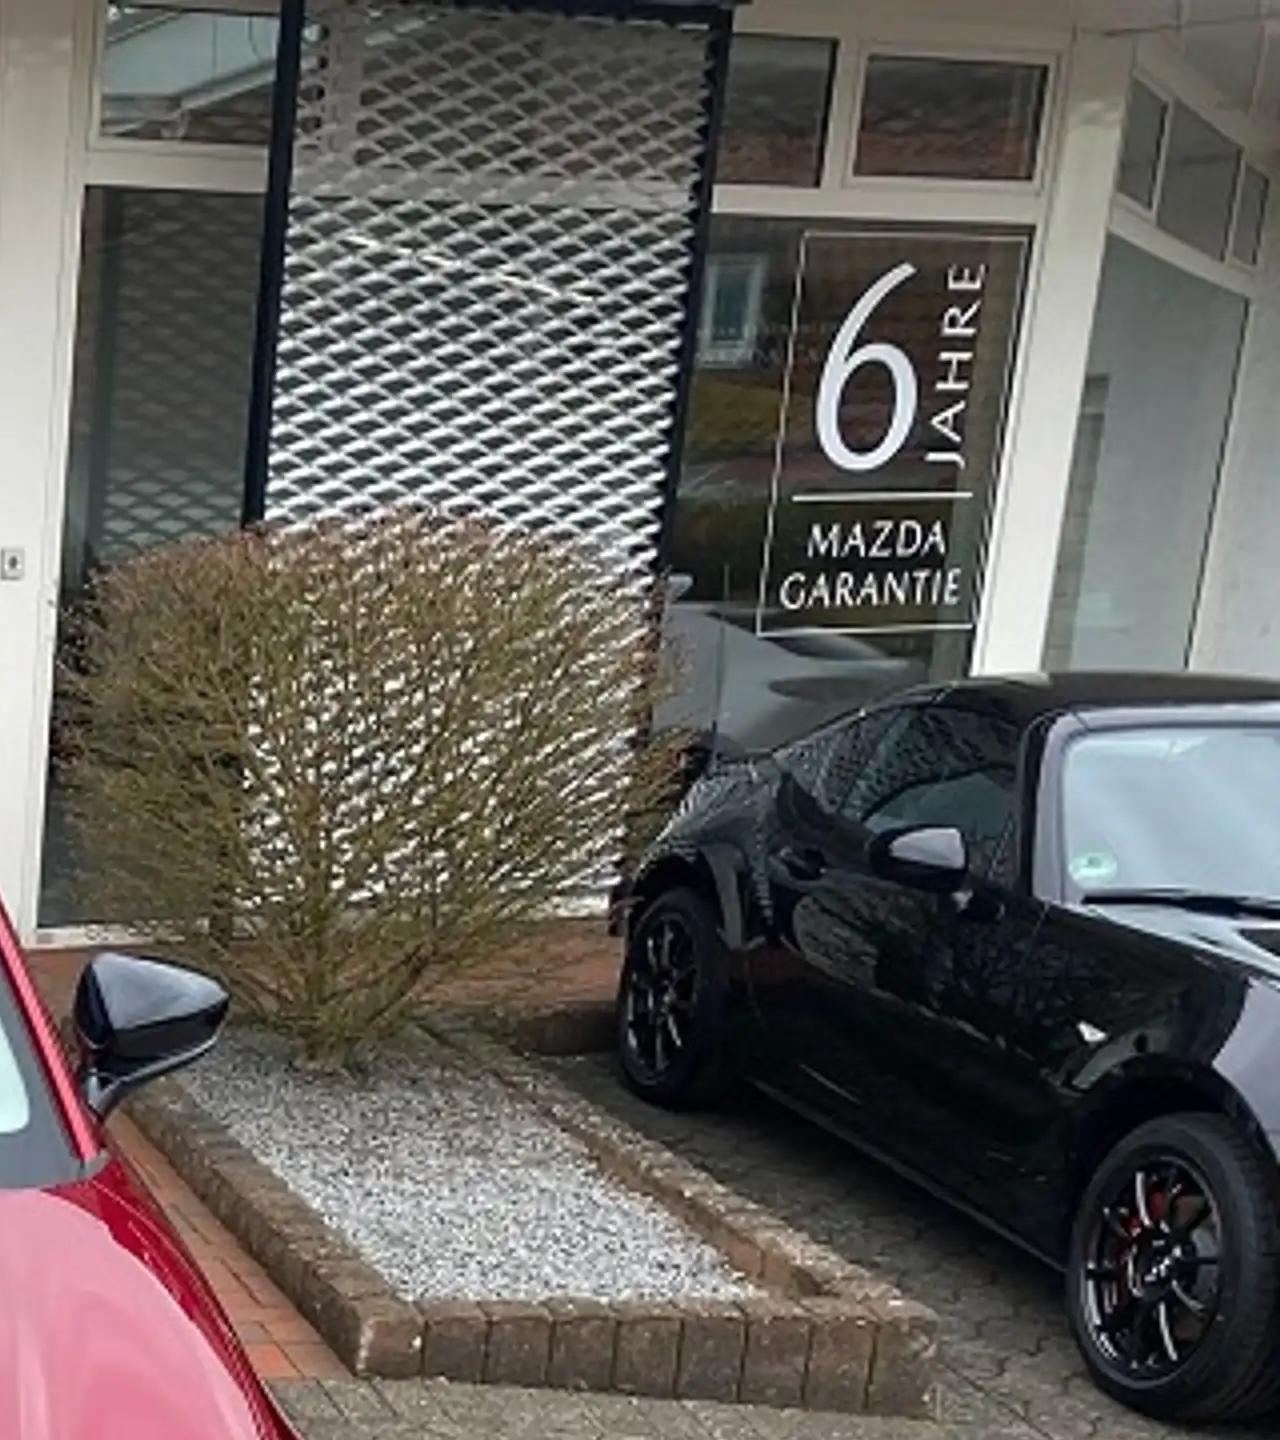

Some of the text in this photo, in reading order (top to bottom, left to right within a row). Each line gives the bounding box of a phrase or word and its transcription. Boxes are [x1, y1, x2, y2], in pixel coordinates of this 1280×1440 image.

[819, 262, 917, 470] 6
[924, 262, 986, 470] JAHRE
[779, 567, 962, 611] GARANTIE
[807, 520, 945, 558] MAZDA
